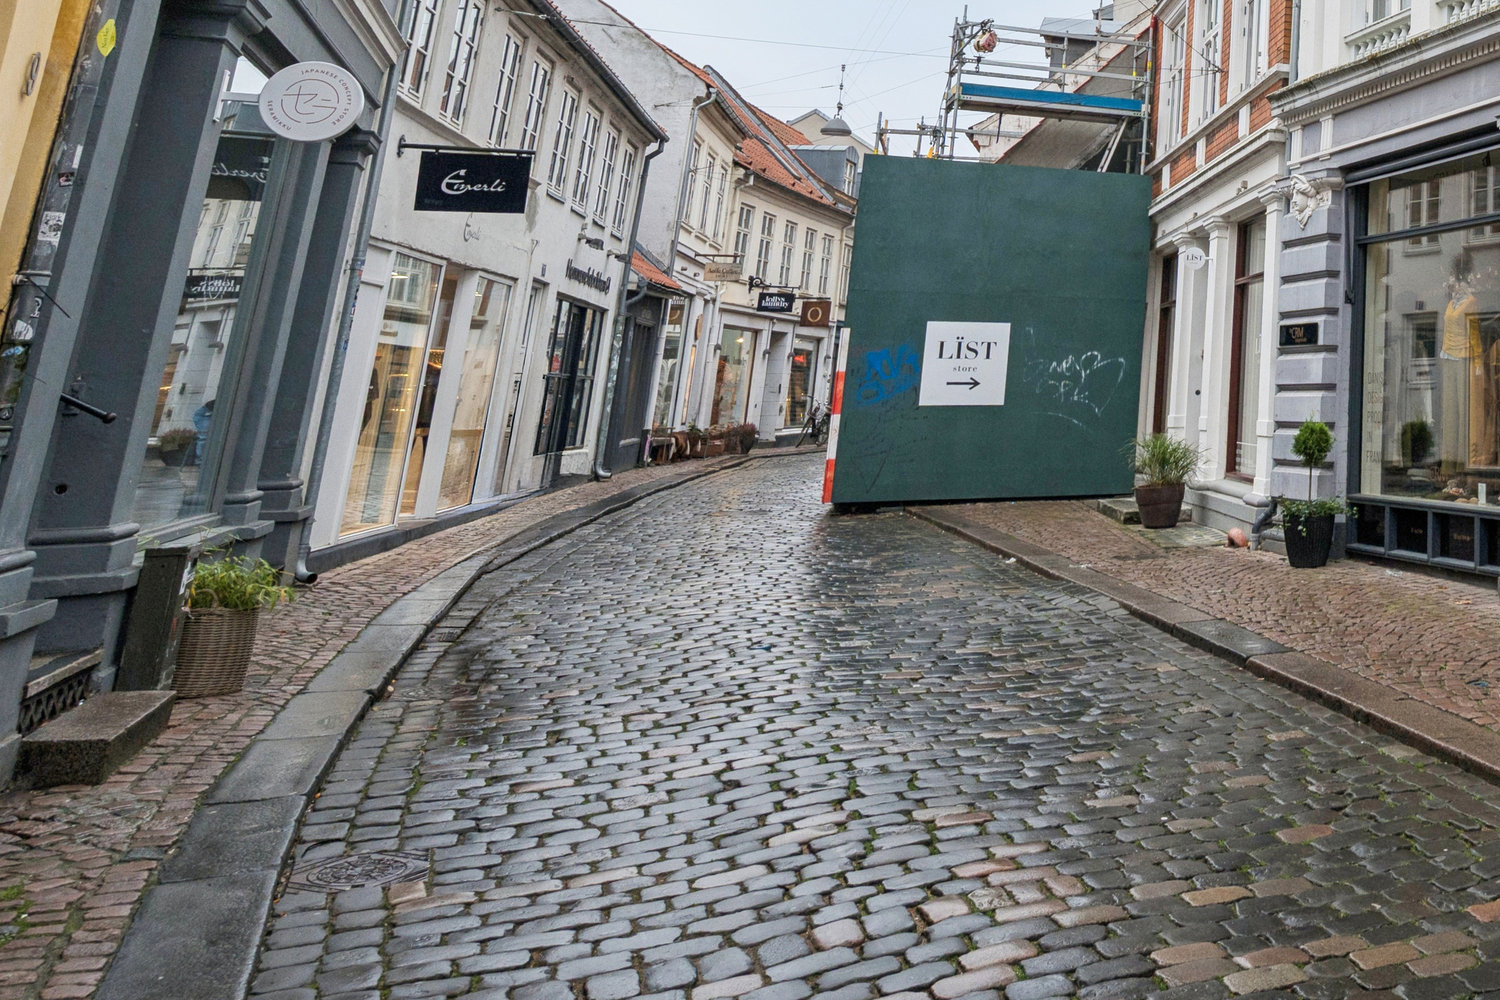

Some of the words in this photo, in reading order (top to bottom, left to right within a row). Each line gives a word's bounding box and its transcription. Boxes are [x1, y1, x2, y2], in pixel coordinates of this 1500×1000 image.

[301, 69, 338, 79] JAPANESE
[339, 79, 352, 105] CONCEPT
[267, 100, 292, 131] SERAMIKKU
[332, 108, 349, 126] STORE
[441, 169, 506, 194] Emerli
[936, 336, 998, 360] LÏST
[953, 365, 978, 373] store
